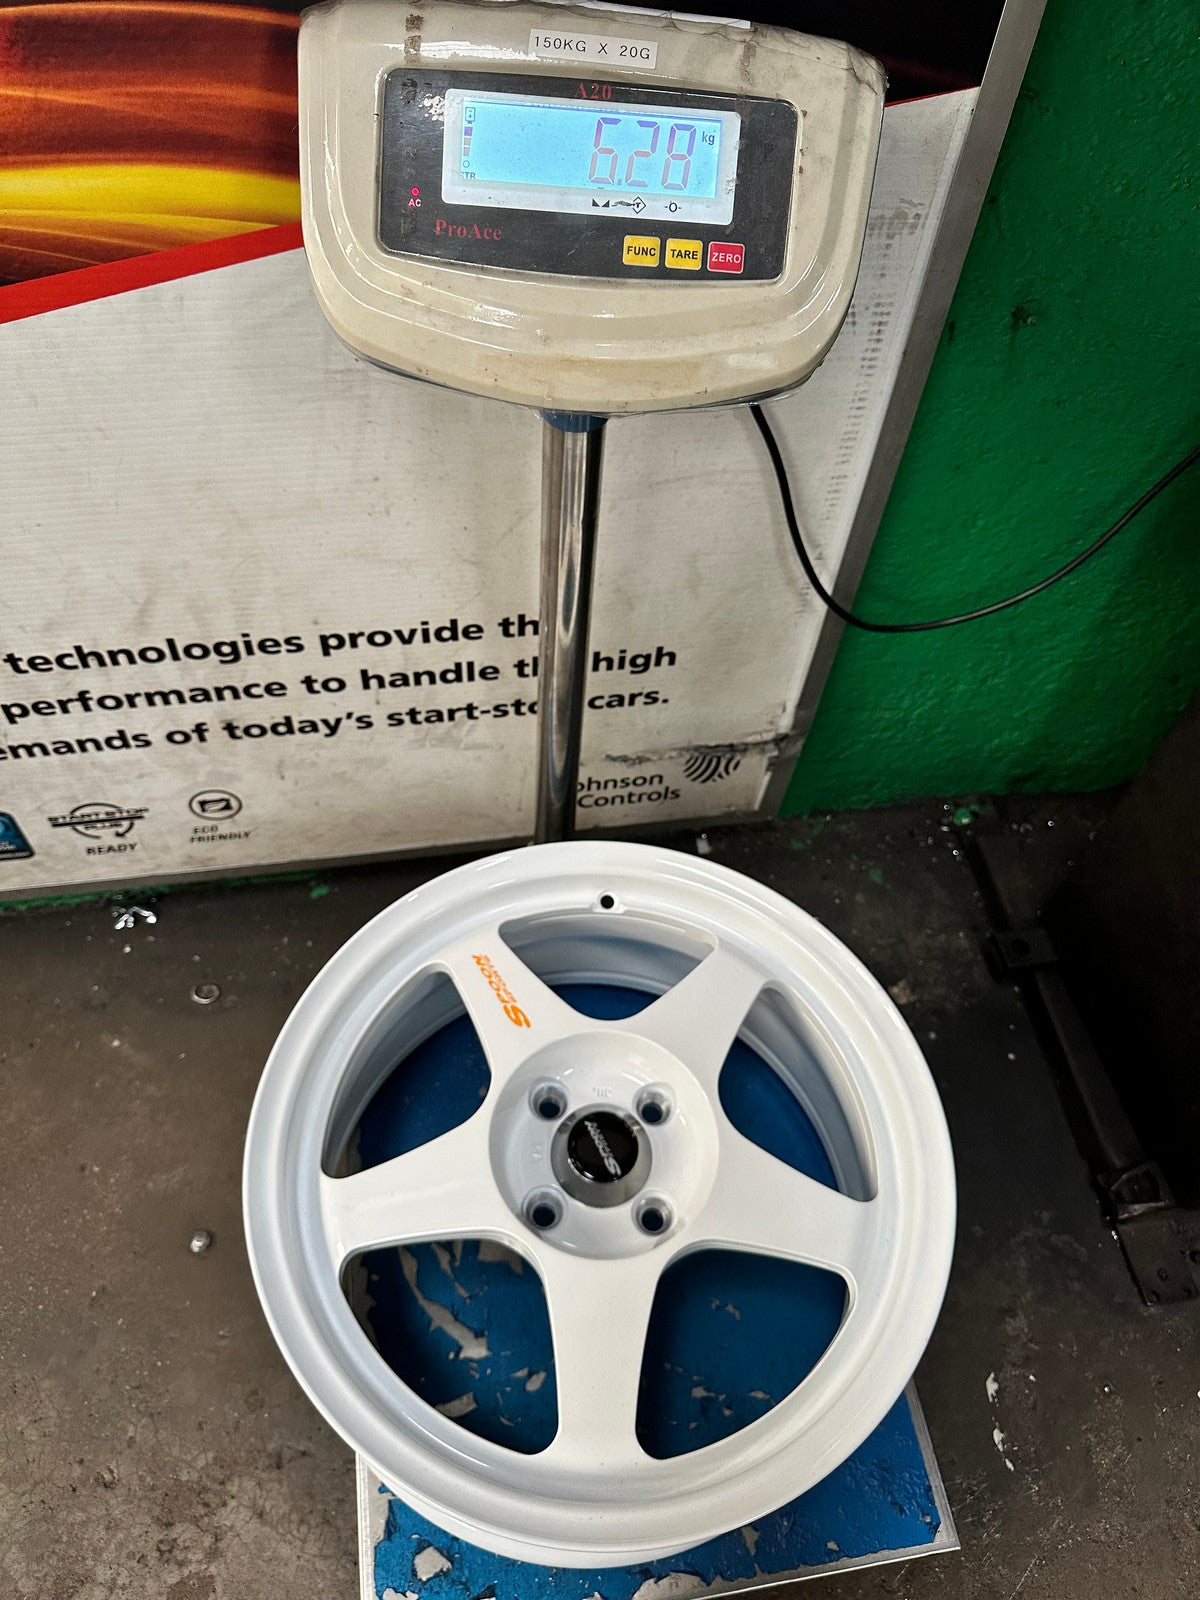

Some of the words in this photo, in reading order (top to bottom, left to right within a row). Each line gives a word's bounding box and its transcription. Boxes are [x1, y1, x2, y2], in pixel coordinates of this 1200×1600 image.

[534, 36, 587, 52] 150KG
[597, 43, 608, 54] X
[619, 45, 650, 60] 20G
[575, 82, 612, 100] A20
[589, 117, 696, 190] 6.28
[701, 131, 716, 146] kg
[408, 198, 422, 208] AC
[433, 219, 502, 240] ProAce
[626, 246, 656, 257] FUNC
[670, 250, 698, 260] TARE
[712, 252, 742, 264] ZERO
[3, 633, 305, 674] technologies
[319, 619, 484, 657] provide
[498, 614, 540, 638] th
[0, 680, 288, 724] performance
[300, 675, 347, 695] to
[360, 661, 500, 690] handle
[592, 646, 677, 675] high
[166, 722, 209, 746] of
[222, 712, 374, 738] today's
[588, 690, 669, 710] cars.
[578, 786, 680, 808] Controls
[190, 831, 251, 844] FRIENDLY
[192, 824, 218, 834] ECO
[86, 843, 138, 856] READY
[472, 954, 532, 1028] SPOON
